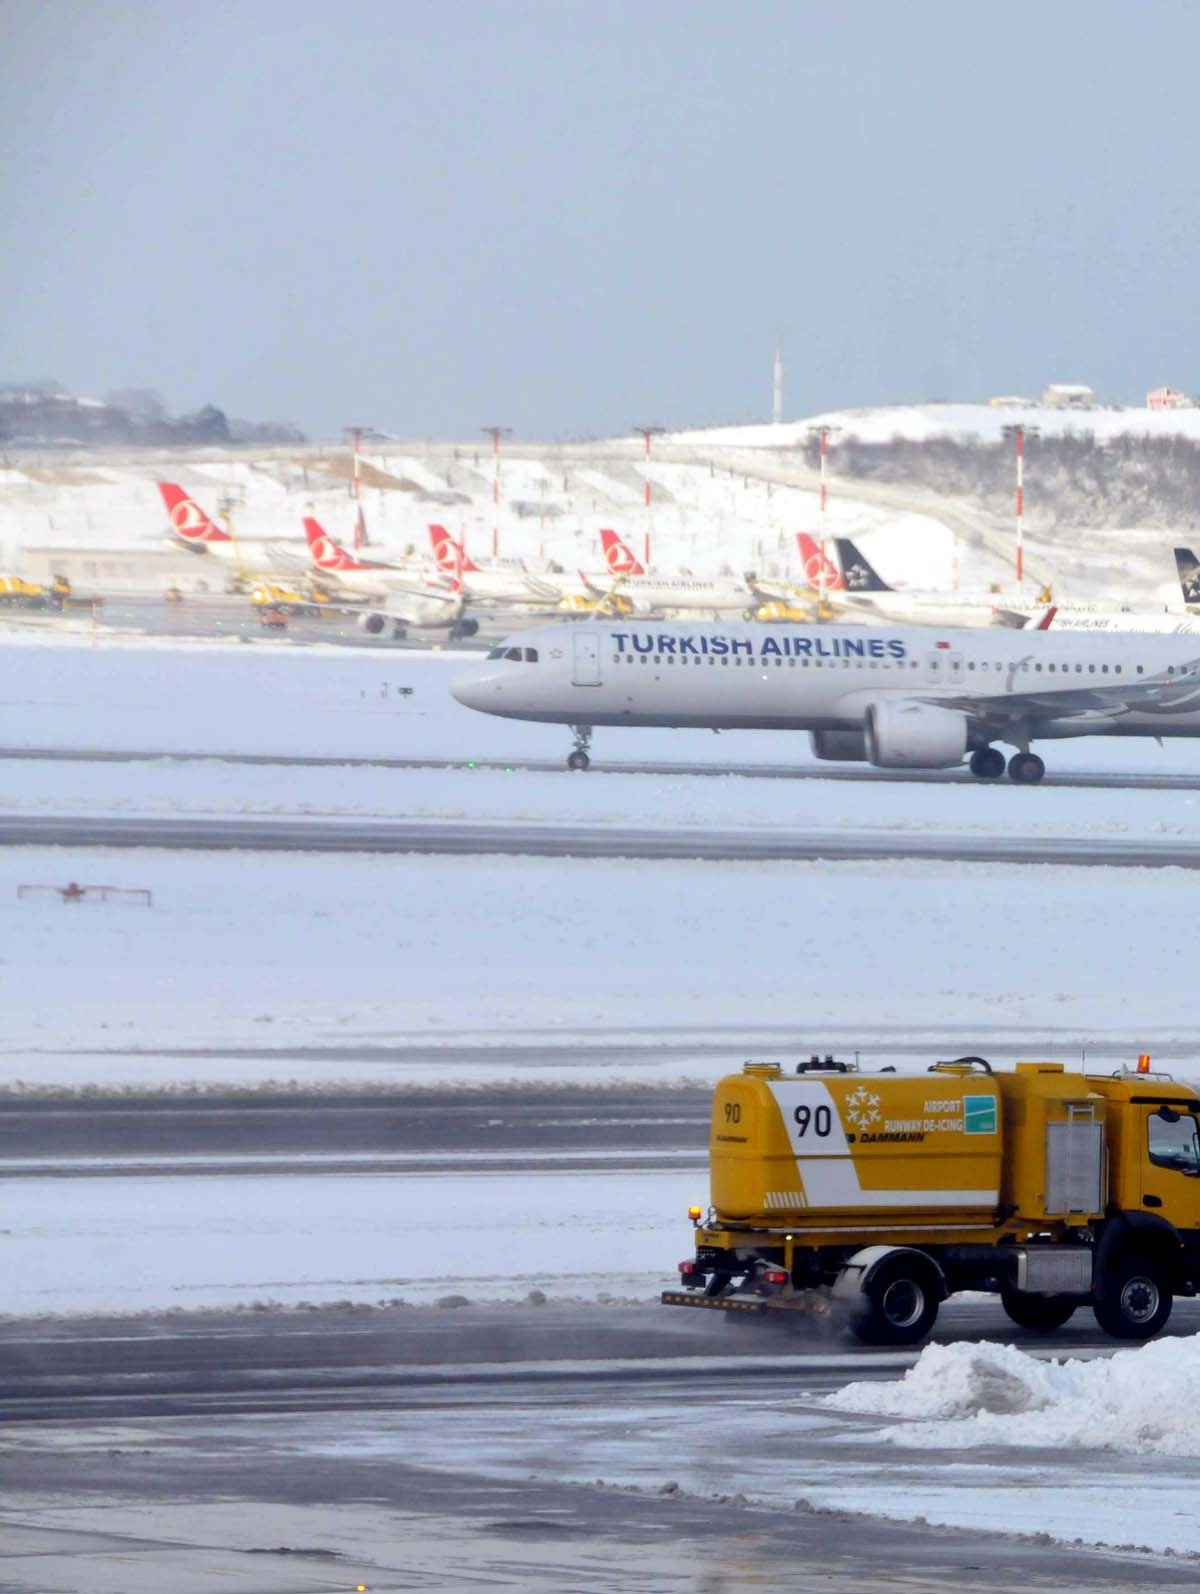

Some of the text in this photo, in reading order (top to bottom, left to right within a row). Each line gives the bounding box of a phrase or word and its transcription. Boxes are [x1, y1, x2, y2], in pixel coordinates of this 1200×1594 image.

[611, 633, 906, 657] TURKISH AIRLINES
[725, 1103, 741, 1123] 90
[923, 1100, 961, 1112] AIRPORT
[794, 1105, 831, 1137] 90
[884, 1119, 963, 1132] RUNWAY DE-ICING
[860, 1132, 925, 1143] DAMMANN
